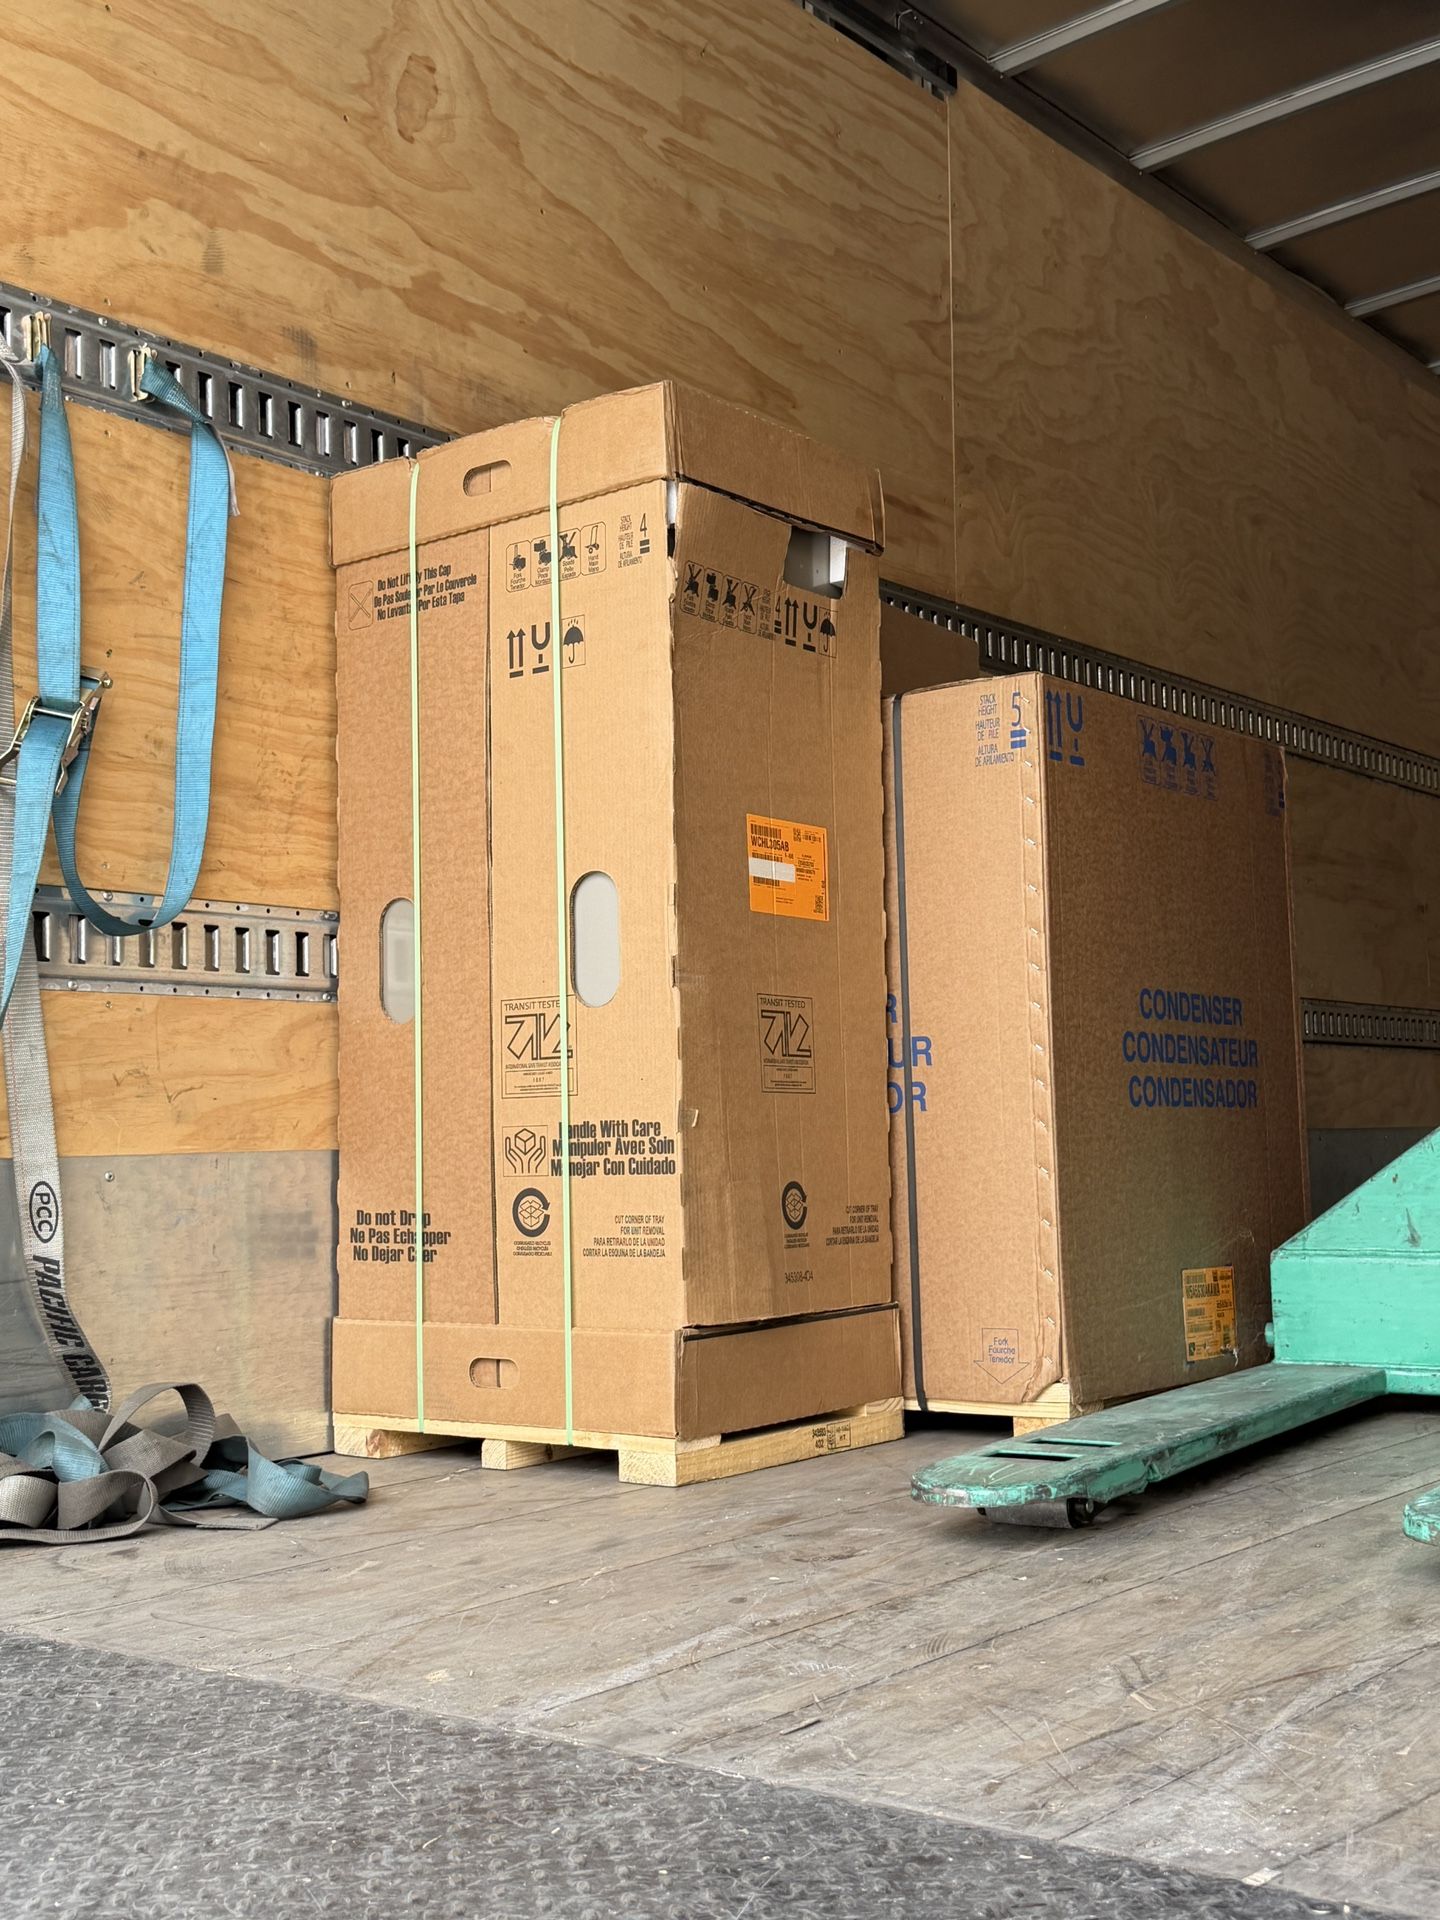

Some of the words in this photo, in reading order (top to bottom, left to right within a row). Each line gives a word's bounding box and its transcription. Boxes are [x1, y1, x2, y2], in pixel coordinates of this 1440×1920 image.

[640, 513, 648, 538] 4
[378, 580, 386, 591] Do
[387, 575, 399, 590] Not
[424, 568, 437, 580] This
[439, 564, 451, 578] Cap
[383, 593, 394, 606] Pas
[424, 584, 435, 596] Par
[437, 581, 444, 593] Le
[445, 572, 477, 591] Couvercle
[377, 608, 386, 621] No
[432, 594, 447, 608] Esta
[449, 591, 465, 605] Tapa
[980, 693, 996, 706] STACK
[1012, 691, 1022, 727] 5
[977, 703, 998, 717] HEIGHT
[504, 1001, 537, 1012] TRANSIT
[538, 999, 560, 1009] TESTE
[784, 999, 806, 1009] TESTED
[1140, 987, 1243, 1026] CONDENSER
[1122, 1031, 1259, 1068] CONDENSATEUR
[1128, 1075, 1258, 1109] CONDENSADOR
[559, 1121, 597, 1139] andle
[600, 1119, 629, 1138] With
[632, 1118, 661, 1137] Care
[552, 1139, 611, 1159] Mnipuler
[615, 1137, 645, 1155] Avec
[648, 1136, 675, 1155] Soin
[550, 1158, 600, 1179] Mnejar
[603, 1157, 625, 1176] Con
[628, 1156, 676, 1176] Cuidado
[34, 1191, 54, 1233] PCC
[356, 1209, 371, 1226] Do
[375, 1210, 396, 1226] not
[399, 1209, 431, 1229] Drp
[614, 1215, 624, 1224] CUT
[624, 1215, 645, 1224] CORNER
[645, 1215, 652, 1224] OF
[652, 1214, 665, 1224] TRAY
[350, 1227, 365, 1244] Ne
[368, 1228, 390, 1244] Pas
[620, 1226, 631, 1236] FOR
[642, 1226, 665, 1236] REMOVAL
[593, 1237, 606, 1246] PARA
[353, 1245, 368, 1262] No
[371, 1245, 404, 1264] Dejar
[407, 1246, 437, 1262] Cer
[32, 1254, 85, 1349] PACIFIC
[988, 1344, 1016, 1355] Fourche
[993, 1336, 1009, 1346] Fork
[988, 1353, 1015, 1364] Tenedor
